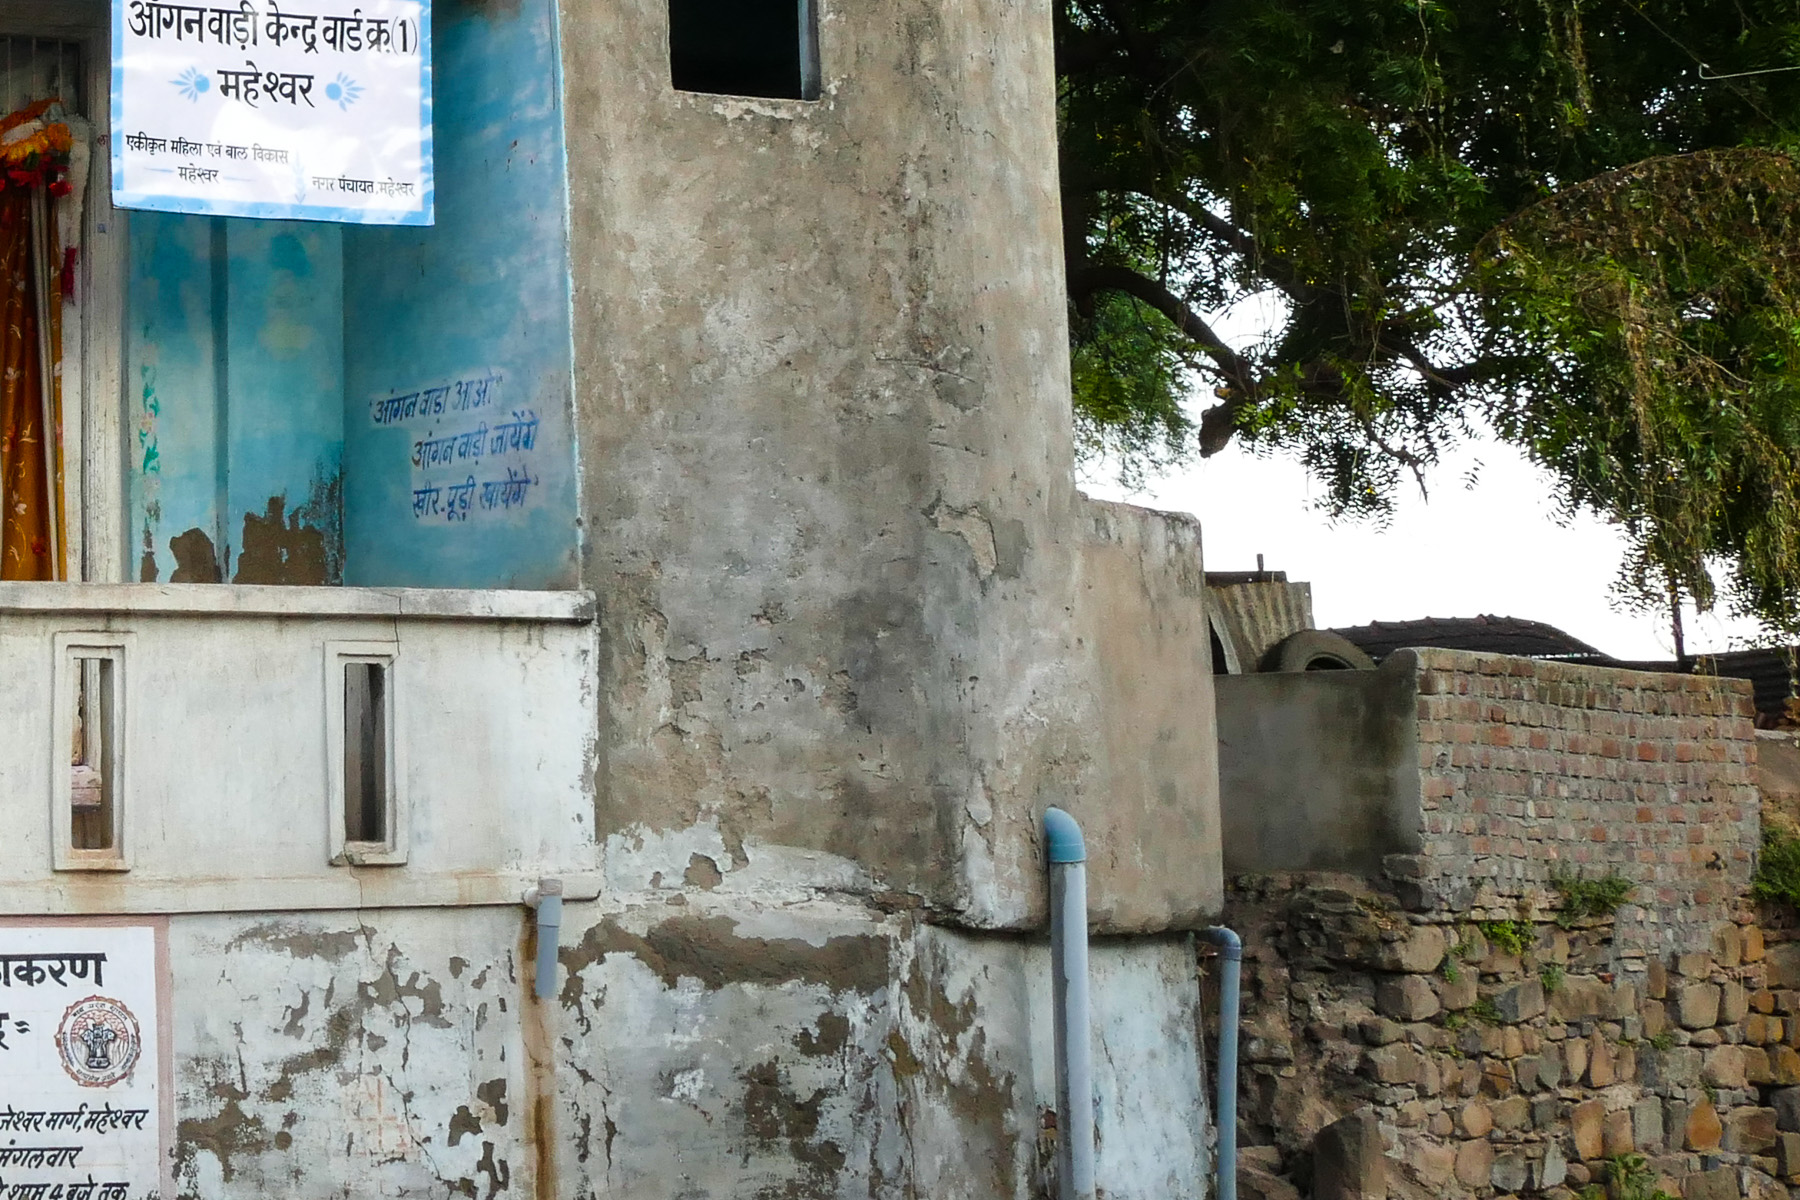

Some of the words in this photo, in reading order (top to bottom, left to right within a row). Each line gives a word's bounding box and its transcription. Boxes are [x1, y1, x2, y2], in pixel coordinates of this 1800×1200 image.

[265, 0, 319, 54] केन्द्र
[322, 8, 363, 53] वार्ड
[217, 60, 315, 109] महेश्वर
[126, 131, 167, 155] एकीकृत
[170, 137, 203, 157] महिला
[206, 140, 222, 158] एवं
[225, 145, 248, 160] बाल
[252, 143, 289, 164] विकास
[178, 163, 220, 185] महेश्वर
[312, 176, 336, 191] नगर
[378, 177, 416, 198] महेश्वर
